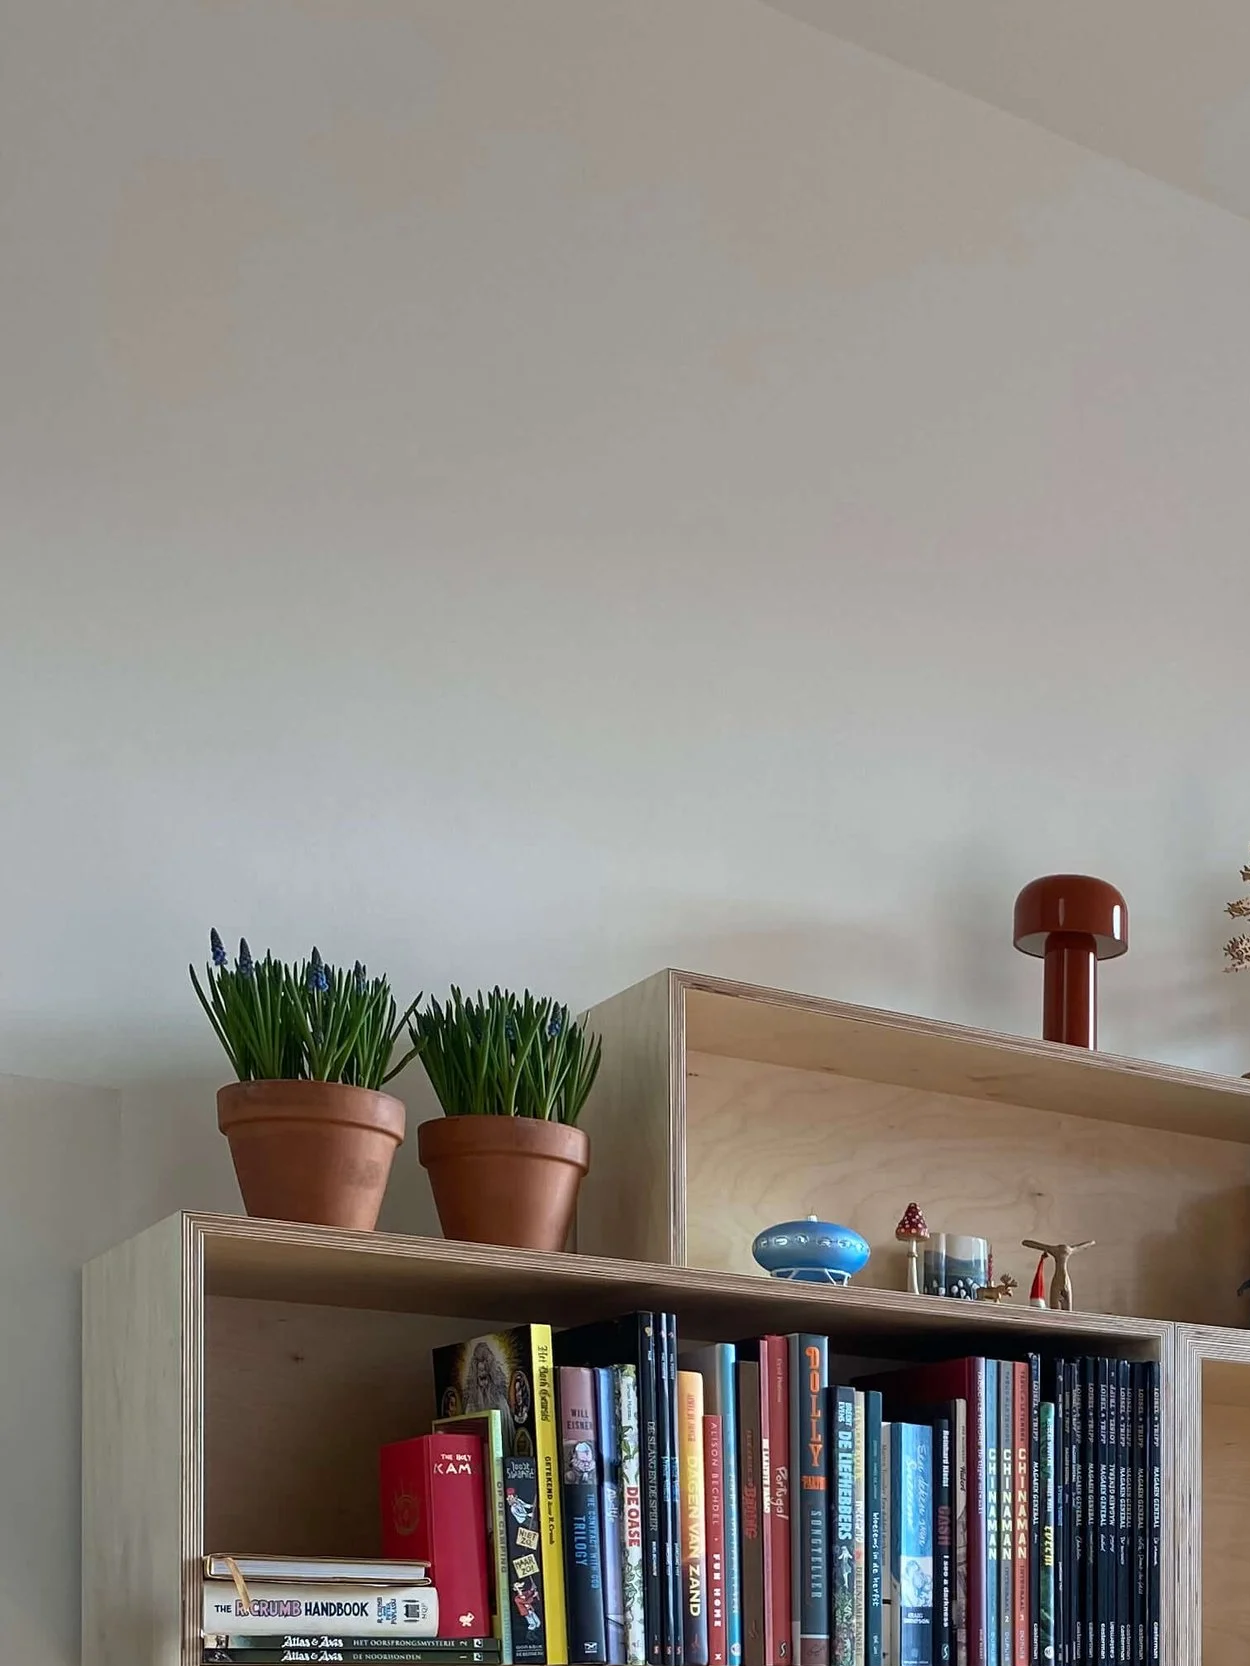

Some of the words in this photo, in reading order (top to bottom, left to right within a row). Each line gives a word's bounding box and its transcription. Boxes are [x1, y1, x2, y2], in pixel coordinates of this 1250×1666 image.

[571, 1409, 588, 1418] WILL
[805, 1346, 823, 1467] DOLLY
[648, 1421, 655, 1434] DE
[711, 1422, 720, 1466] ALISON
[838, 1431, 853, 1448] DE
[433, 1462, 472, 1475] KAM
[440, 1453, 454, 1461] THE
[456, 1453, 471, 1462] HOLY
[648, 1436, 656, 1469] SLANG
[545, 1456, 553, 1500] GETEKEND
[686, 1455, 700, 1521] DAGEN
[769, 1466, 789, 1520] Portugal
[587, 1494, 595, 1507] THE
[627, 1487, 638, 1505] DE
[711, 1471, 721, 1526] BECHDEL
[838, 1452, 854, 1541] LIEFHEBBERS
[1001, 1448, 1013, 1560] CHINAMAN
[1016, 1448, 1027, 1560] CHINAMAN
[588, 1511, 597, 1548] CONTRACT
[628, 1508, 640, 1547] OASE
[649, 1499, 658, 1532] SPEER
[872, 1512, 880, 1549] bloesems
[938, 1505, 951, 1546] CASH
[573, 1516, 587, 1566] TRILOGY
[688, 1524, 701, 1558] VAN
[810, 1510, 823, 1599] SONGTELLER
[590, 1553, 598, 1571] WITH
[713, 1554, 721, 1582] FUN
[591, 1574, 599, 1588] GOD
[689, 1565, 700, 1617] ZAND
[872, 1577, 881, 1607] herfst
[215, 1604, 231, 1612] THE
[304, 1602, 368, 1616] HANDBOOK
[713, 1589, 721, 1627] HOME
[281, 1635, 310, 1648] Atlas
[281, 1651, 310, 1662] Atlas
